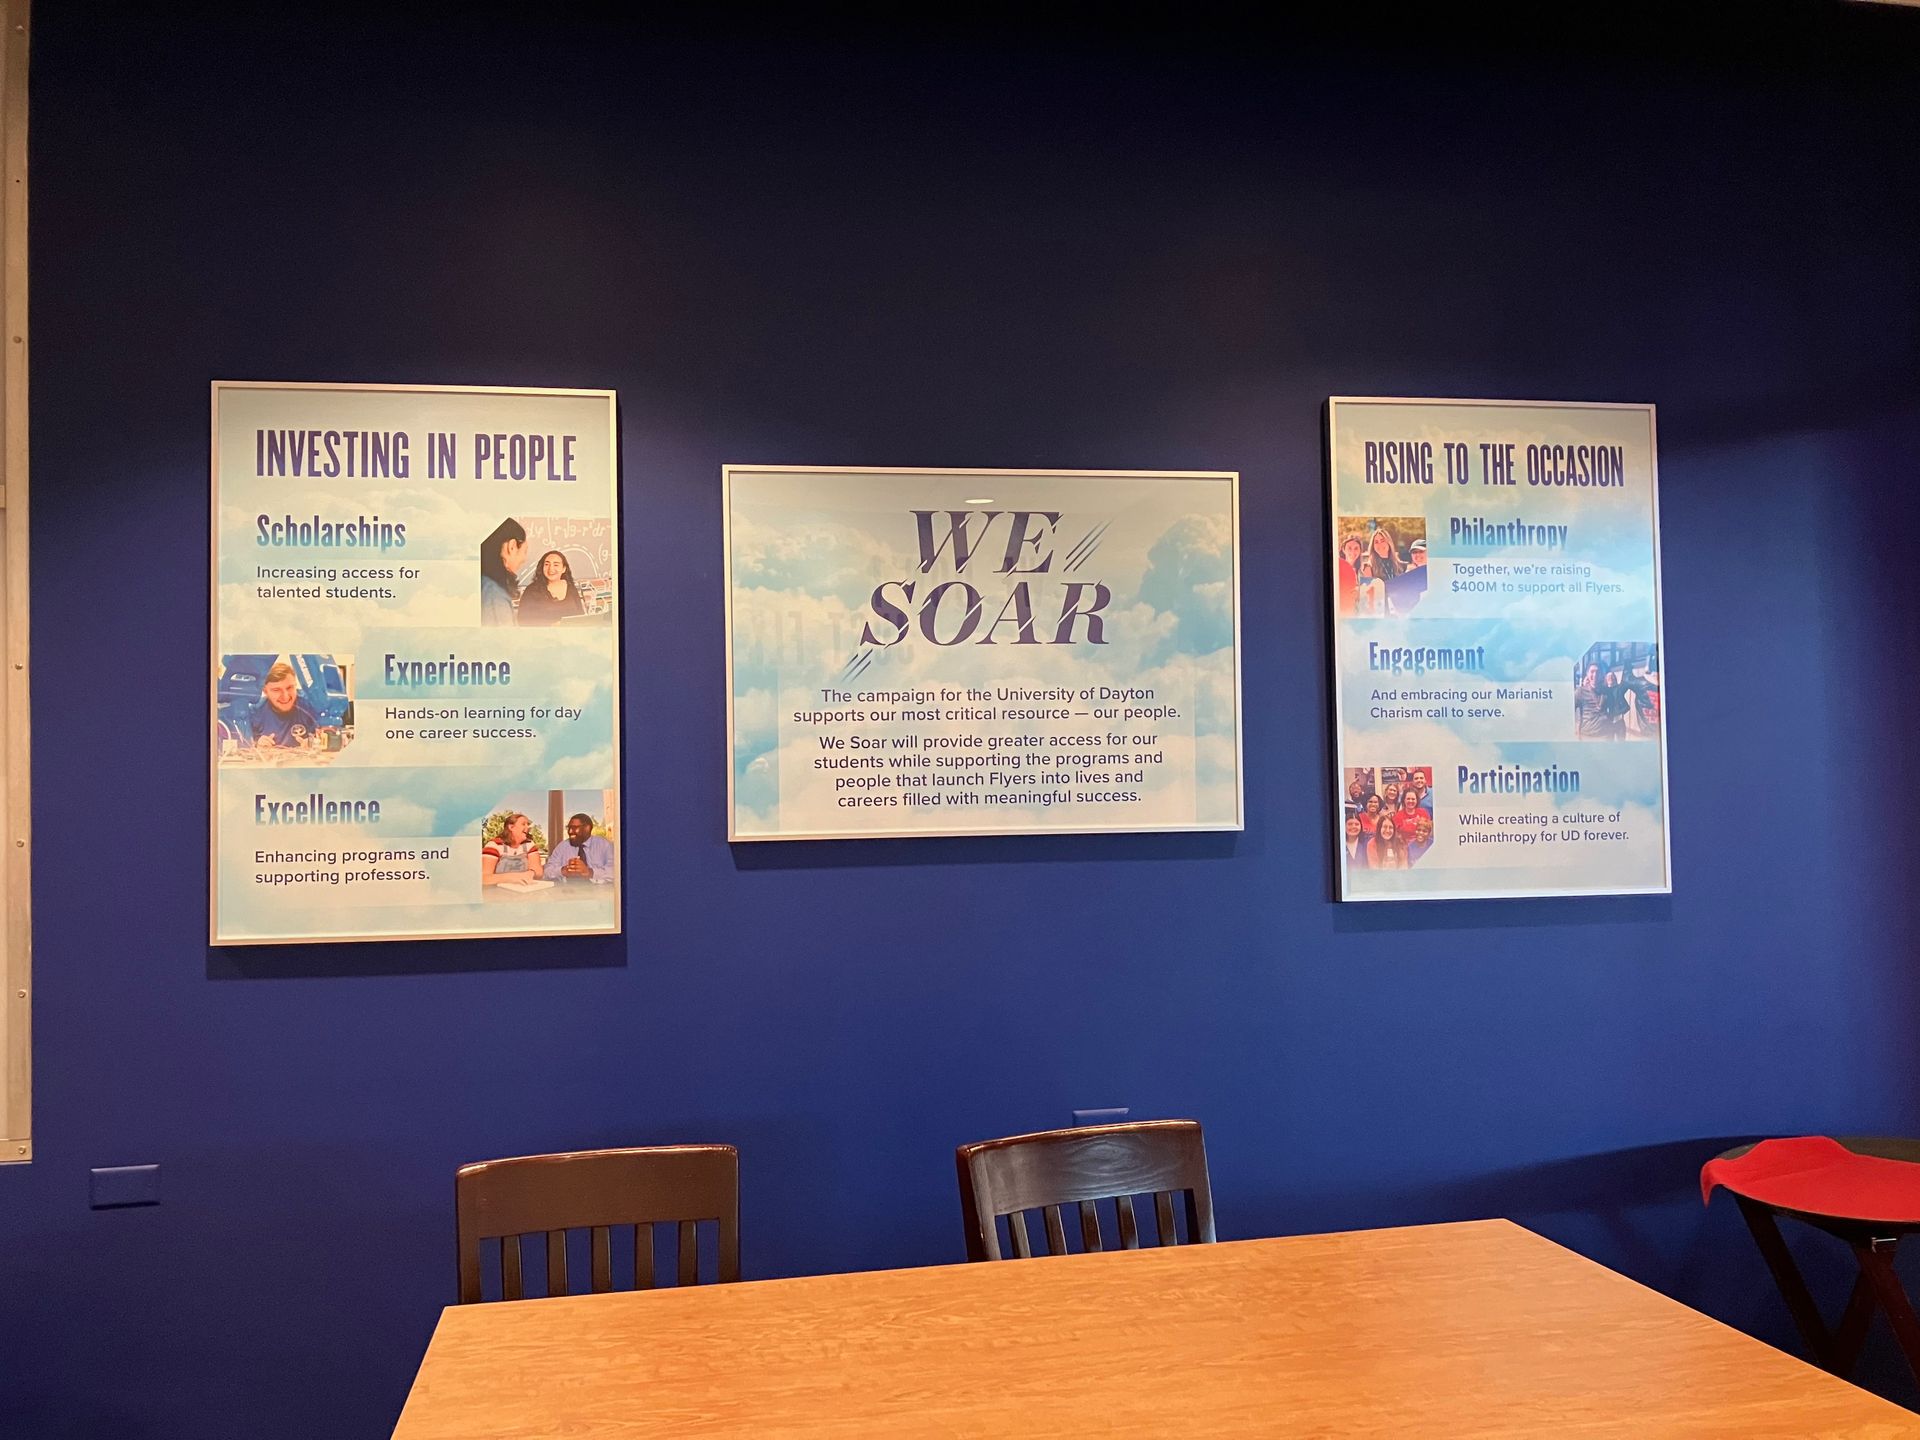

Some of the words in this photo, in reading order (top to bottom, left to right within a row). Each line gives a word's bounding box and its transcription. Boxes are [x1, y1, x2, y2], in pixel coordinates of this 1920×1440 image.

[257, 430, 409, 478] INVESTING
[428, 433, 456, 479] IN
[475, 434, 576, 481] PEOPLE
[1365, 441, 1433, 484] RISING
[1444, 443, 1468, 485] TO
[1480, 444, 1516, 485] THE
[1527, 444, 1623, 487] OCCASION
[256, 514, 406, 551] Scholarships
[1450, 517, 1568, 549] Philanthropy
[909, 510, 1065, 575] WE
[257, 565, 337, 582] Increasing
[341, 569, 394, 579] access
[398, 566, 421, 579] for
[1452, 563, 1510, 578] Together,
[1512, 563, 1548, 575] we're
[1550, 563, 1591, 578] raising
[256, 585, 321, 599] talented
[325, 585, 397, 599] students.
[1451, 579, 1497, 593] $400M
[1501, 581, 1515, 593] to
[1517, 582, 1566, 596] support
[1568, 581, 1582, 593] all
[1585, 580, 1625, 596] Flyers.
[860, 580, 1112, 648] SOAR
[1370, 642, 1484, 676] Engagement
[385, 654, 510, 688] Experience
[820, 688, 852, 703] The
[857, 688, 935, 705] campaign
[940, 687, 963, 702] for
[966, 688, 992, 702] the
[997, 686, 1075, 704] University
[1079, 686, 1096, 701] of
[1099, 686, 1154, 704] Dayton
[1370, 689, 1397, 701] And
[1400, 688, 1468, 703] embracing
[1471, 691, 1493, 700] our
[1496, 687, 1553, 700] Marianist
[385, 706, 459, 720] Hands-on
[464, 706, 526, 722] learning
[529, 706, 552, 719] for
[554, 706, 582, 721] day
[793, 709, 865, 726] supports
[869, 711, 897, 722] our
[901, 708, 941, 721] most
[945, 706, 997, 721] critical
[1001, 709, 1070, 720] resource
[1093, 708, 1120, 719] our
[1124, 704, 1181, 722] people.
[1370, 706, 1423, 719] Charism
[1426, 706, 1448, 718] call
[1450, 707, 1464, 718] to
[1467, 708, 1505, 718] serve.
[385, 729, 415, 740] one
[419, 729, 469, 739] career
[472, 728, 537, 739] success.
[818, 735, 845, 750] We
[850, 735, 888, 750] Soar
[891, 734, 918, 749] will
[923, 733, 983, 752] provide
[987, 734, 1045, 751] greater
[1049, 735, 1102, 747] access
[1105, 732, 1128, 746] for
[1132, 735, 1158, 746] our
[814, 755, 884, 769] students
[888, 753, 931, 768] while
[935, 752, 1021, 770] supporting
[1025, 752, 1051, 766] the
[1055, 754, 1130, 769] programs
[1134, 750, 1163, 764] and
[835, 773, 892, 792] people
[895, 773, 928, 787] that
[932, 772, 984, 787] launch
[989, 771, 1037, 789] Flyers
[1041, 770, 1071, 785] into
[1075, 770, 1110, 784] lives
[1114, 769, 1143, 784] and
[1458, 765, 1580, 797] Participation
[837, 796, 898, 808] careers
[902, 792, 941, 806] filled
[945, 791, 979, 805] with
[984, 789, 1071, 807] meaningful
[1076, 791, 1142, 803] success.
[255, 793, 380, 827] Excellence
[1458, 813, 1495, 826] While
[1497, 813, 1548, 827] creating
[1551, 815, 1559, 824] a
[1562, 812, 1605, 824] culture
[1608, 810, 1621, 823] of
[1458, 831, 1538, 847] philanthropy
[1540, 830, 1558, 842] for
[1560, 829, 1581, 842] UD
[1583, 829, 1630, 841] forever.
[255, 849, 337, 865] Enhancing
[342, 850, 416, 865] programs
[420, 847, 449, 860] and
[255, 869, 340, 886] supporting
[344, 868, 430, 885] professors.
